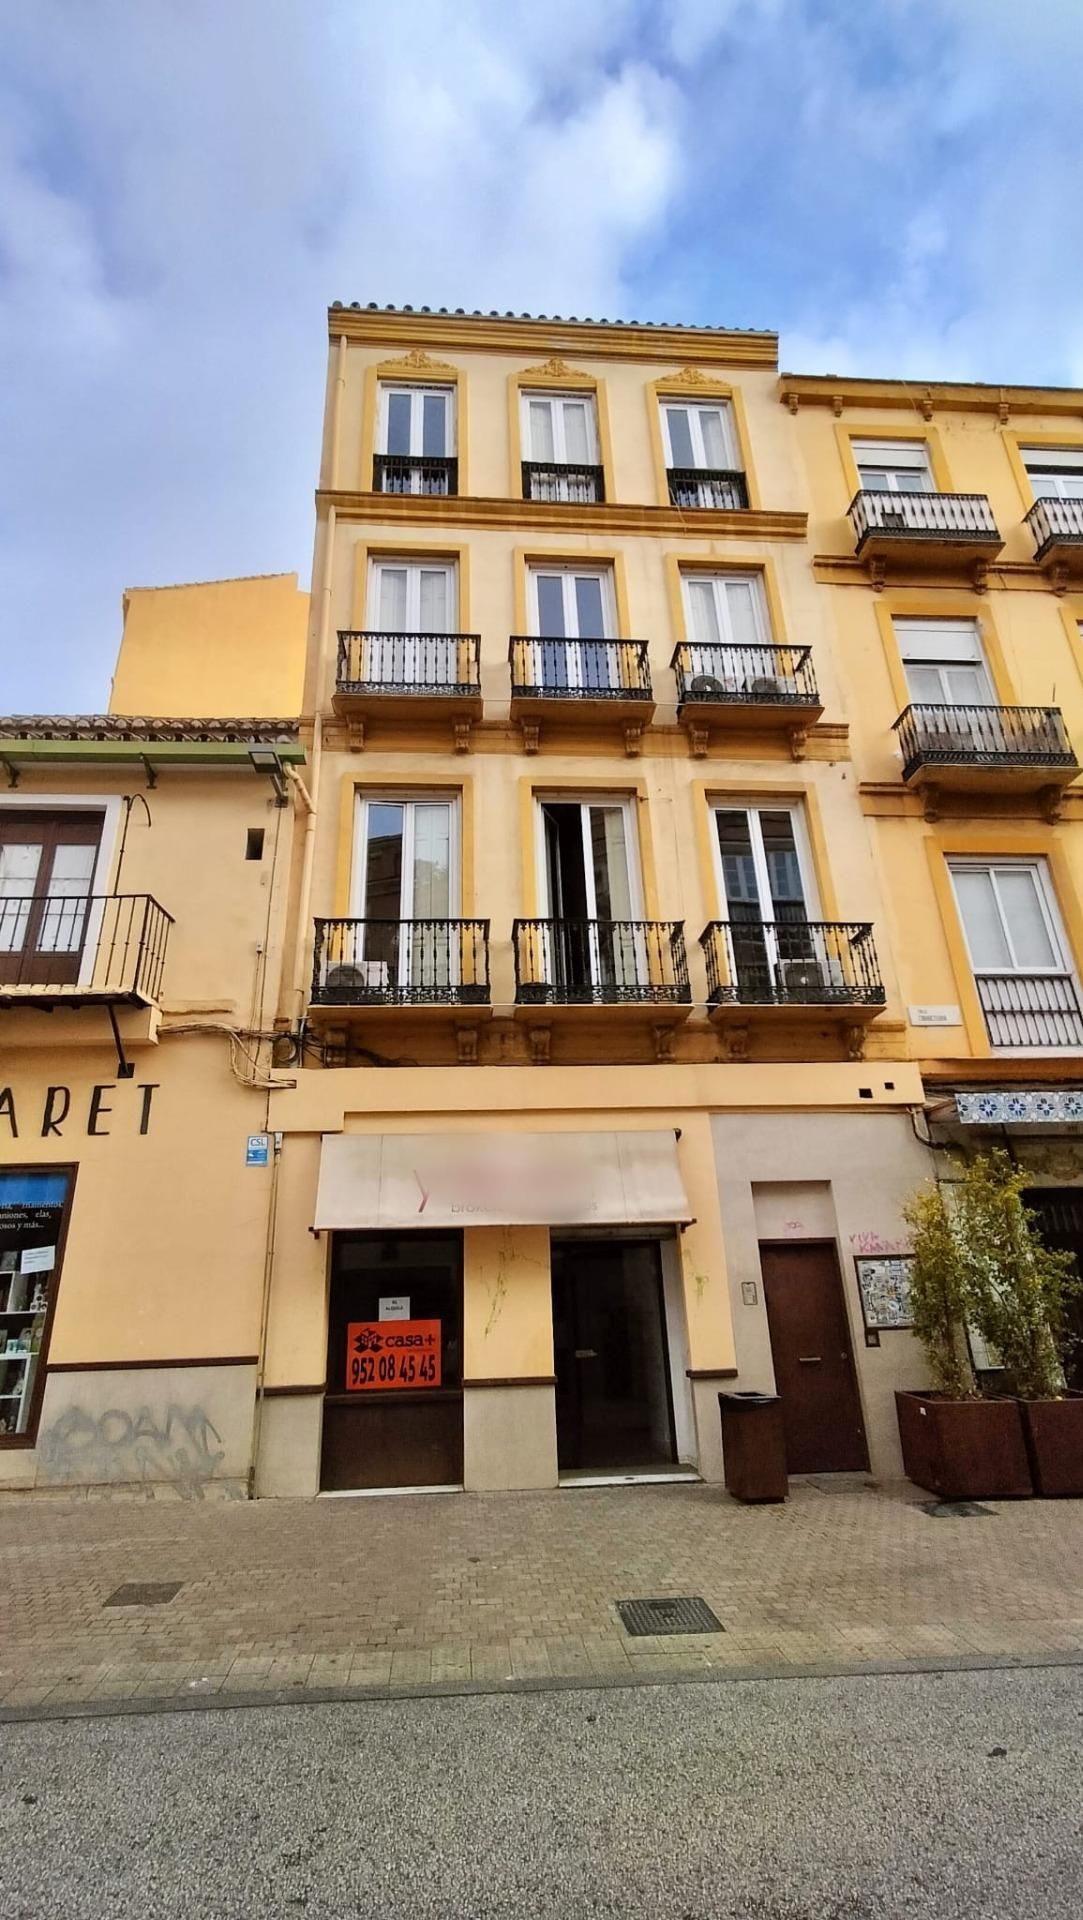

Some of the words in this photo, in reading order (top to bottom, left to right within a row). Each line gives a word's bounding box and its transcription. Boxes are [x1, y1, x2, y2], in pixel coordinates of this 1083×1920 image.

[352, 1357, 375, 1385] 952
[379, 1354, 395, 1382] 08
[399, 1355, 415, 1383] 45
[419, 1354, 436, 1382] 45
